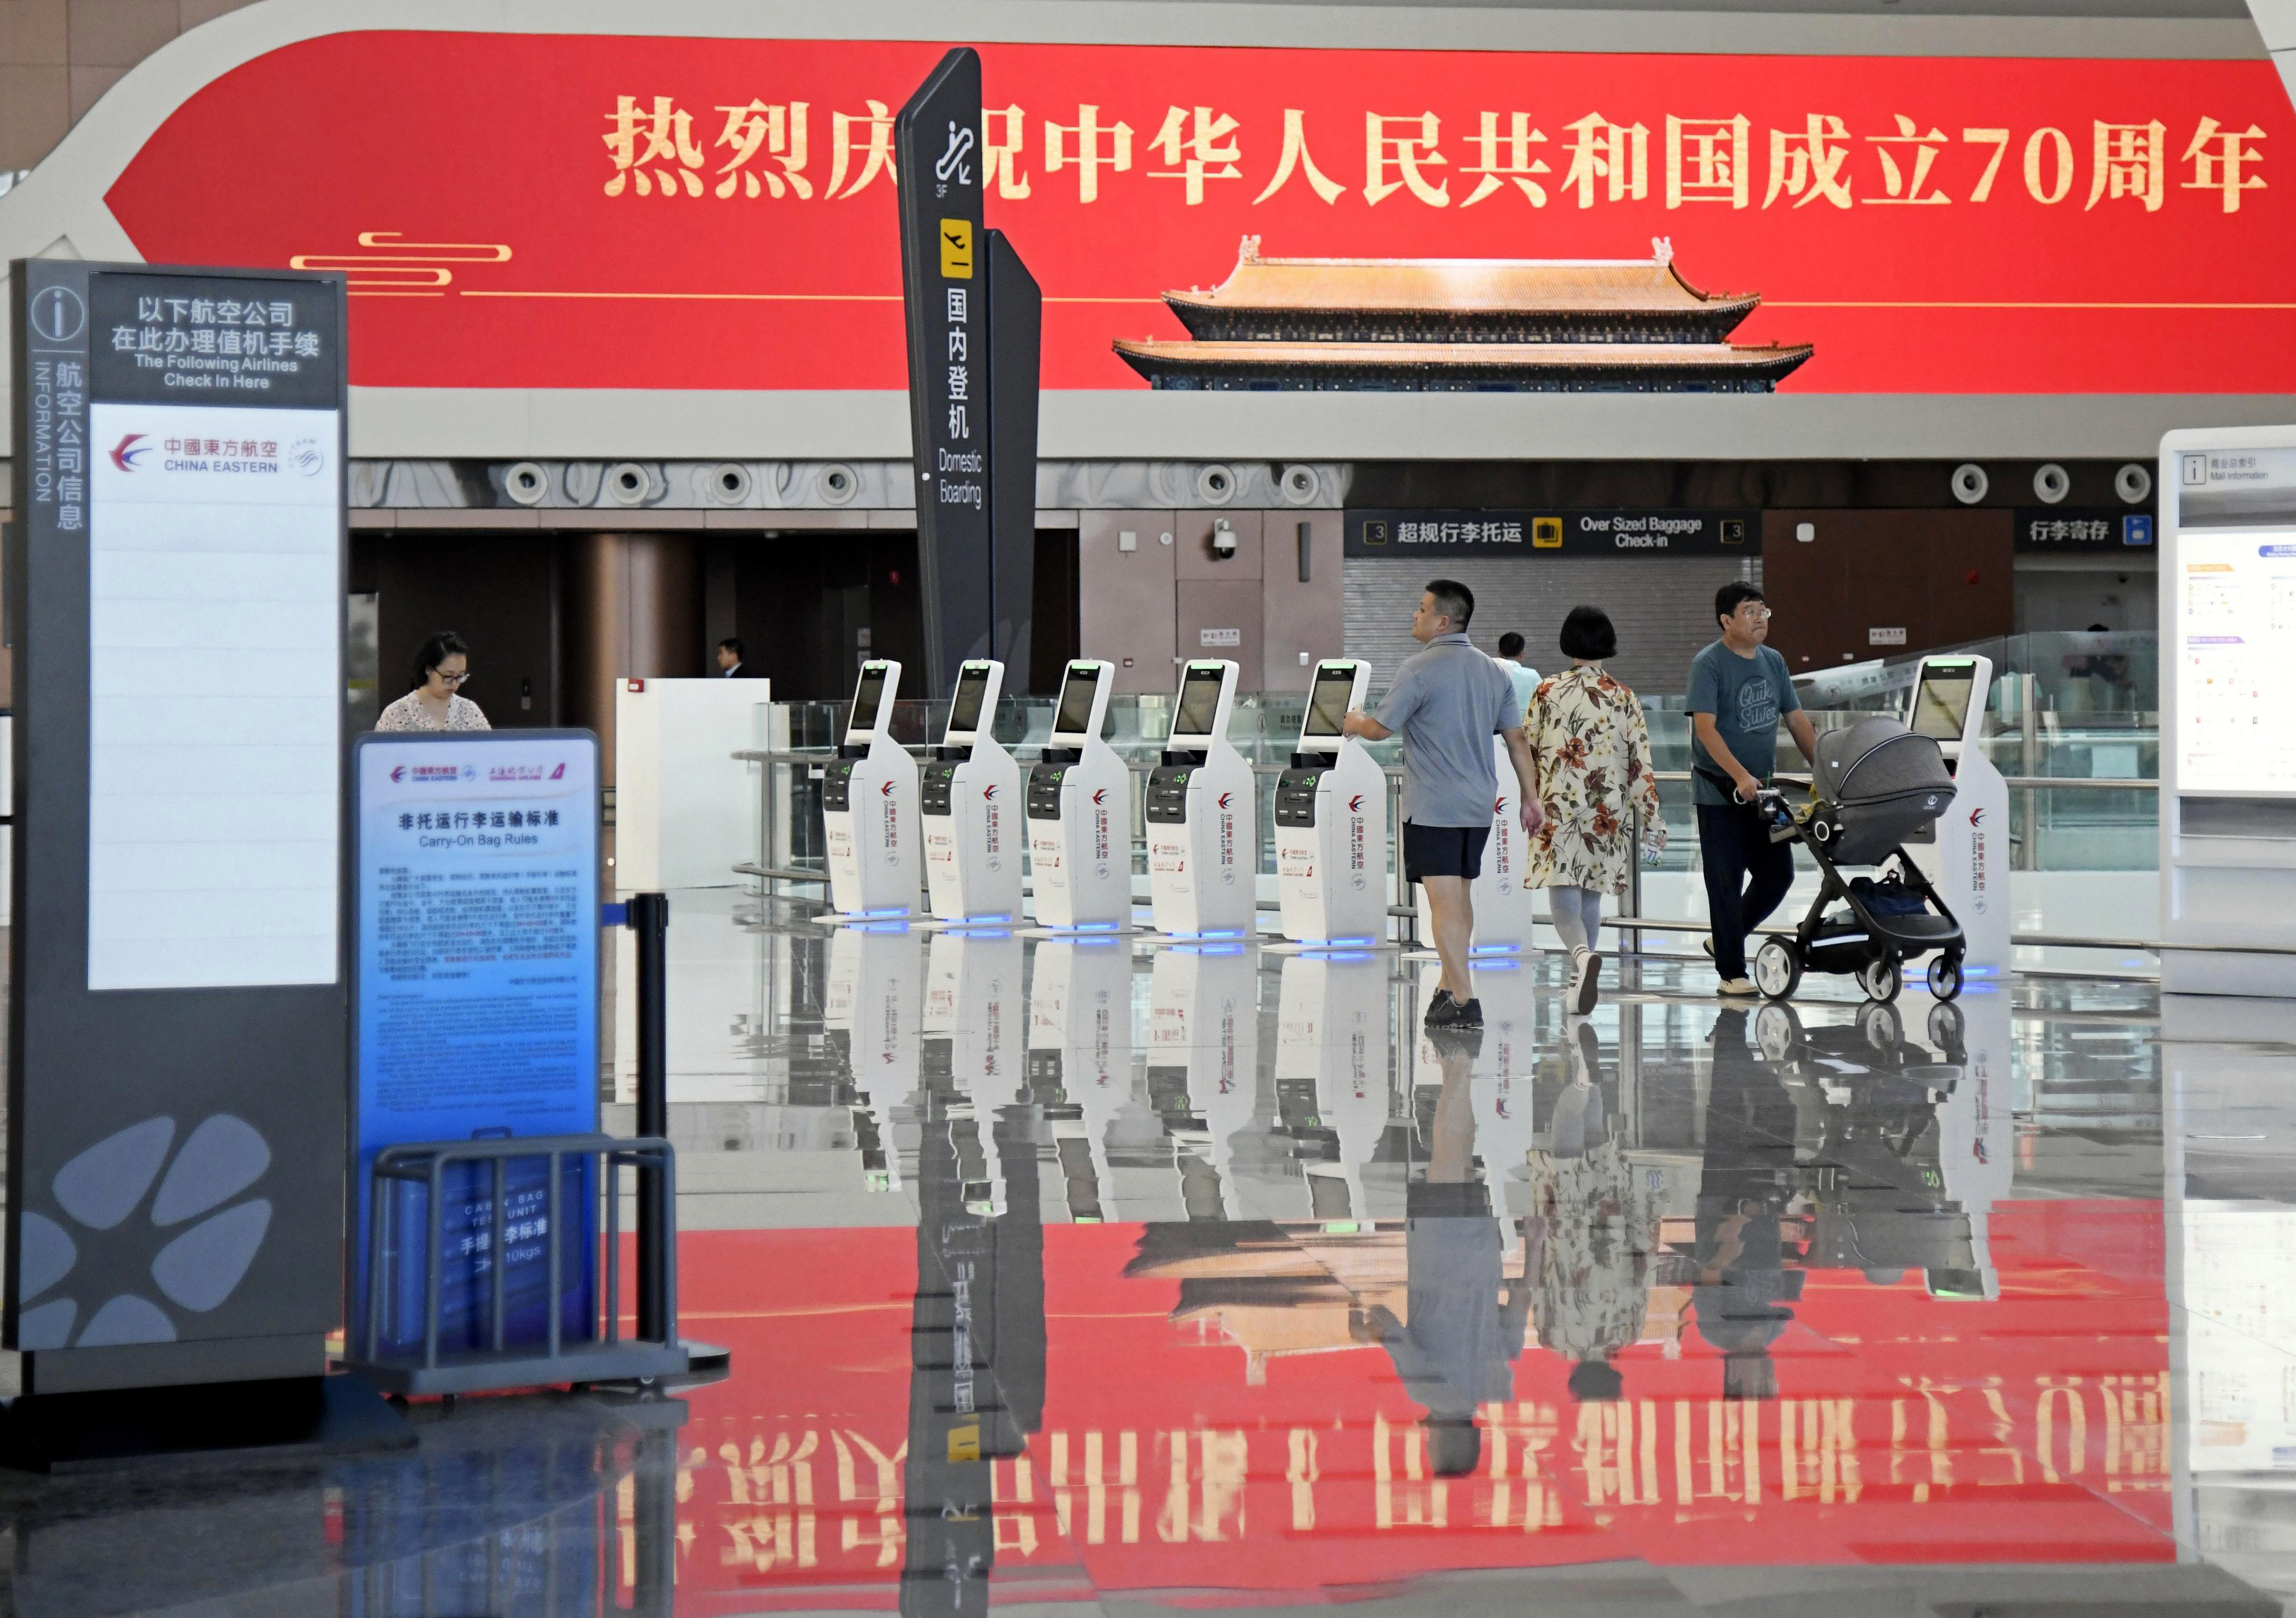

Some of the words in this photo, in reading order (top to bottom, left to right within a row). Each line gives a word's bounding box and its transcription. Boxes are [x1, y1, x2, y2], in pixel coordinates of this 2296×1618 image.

[936, 184, 948, 198] 3F
[138, 296, 292, 326] 以下航空公司
[112, 326, 319, 357] 在此办理值机手续
[135, 354, 163, 367] The
[167, 355, 238, 372] Following
[242, 358, 297, 372] Airlines
[947, 288, 969, 439] 国内登机
[164, 373, 211, 387] Check
[215, 374, 230, 388] In
[233, 374, 269, 389] Here
[35, 362, 51, 502] INFORMATION
[56, 362, 82, 531] 航空公司信息
[164, 438, 278, 458] 中國東方航空
[164, 459, 208, 472] CHINA
[213, 461, 278, 473] EASTERN
[939, 448, 982, 473] Domestic
[940, 479, 982, 510] Boarding
[1375, 525, 1384, 539] 3
[1398, 522, 1522, 543] 超规行李托运
[1580, 516, 1611, 531] Over
[1613, 517, 1647, 531] Sized
[1649, 517, 1702, 534] Baggage
[1732, 524, 1741, 538] 3
[2030, 520, 2109, 541] 行李寄存
[1616, 532, 1668, 548] Check-in
[1740, 679, 1772, 707] Quik
[1739, 707, 1776, 729] Silver
[399, 810, 560, 831] 非托运行李运输标准
[420, 834, 474, 849] Carry-On
[478, 834, 501, 847] Bag
[505, 833, 538, 845] Rules
[518, 1190, 543, 1204] BAG
[507, 1205, 536, 1219] UNIT
[461, 1217, 547, 1255] 手提李标准
[505, 1245, 540, 1262] 10kgs
